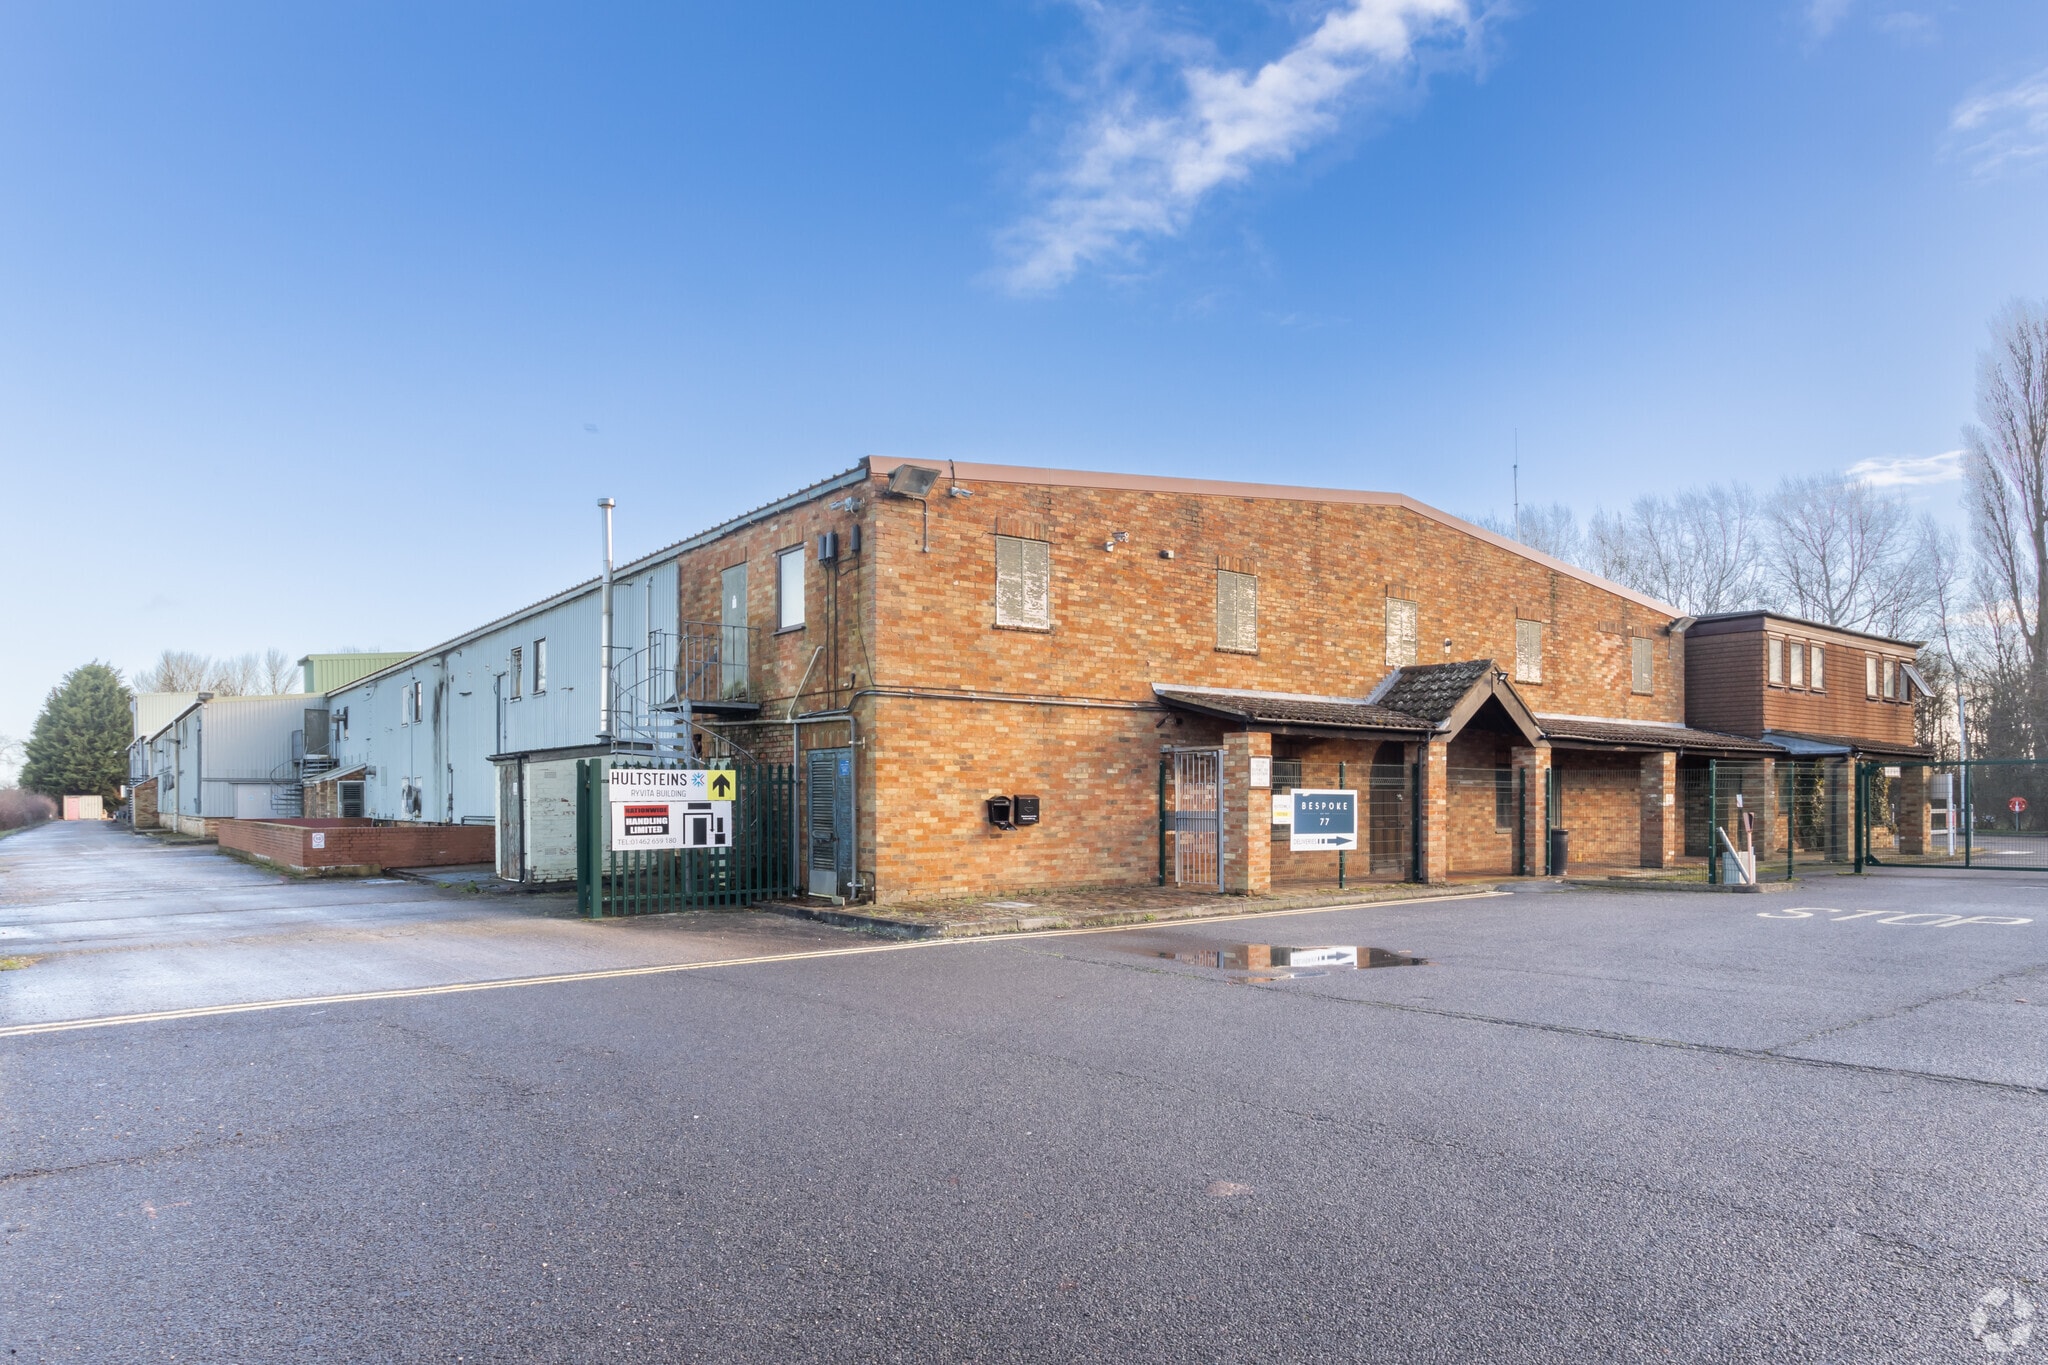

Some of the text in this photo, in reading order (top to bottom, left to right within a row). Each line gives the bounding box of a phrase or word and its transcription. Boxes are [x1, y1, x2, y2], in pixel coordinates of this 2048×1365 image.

[611, 772, 687, 786] HULTSTEINS
[630, 789, 655, 797] RYVITA
[1301, 801, 1348, 810] BESPOKE
[625, 817, 668, 825] HANDLING
[1319, 817, 1330, 826] 77
[630, 826, 663, 834] LIMITED
[1756, 907, 2034, 928] STOP
